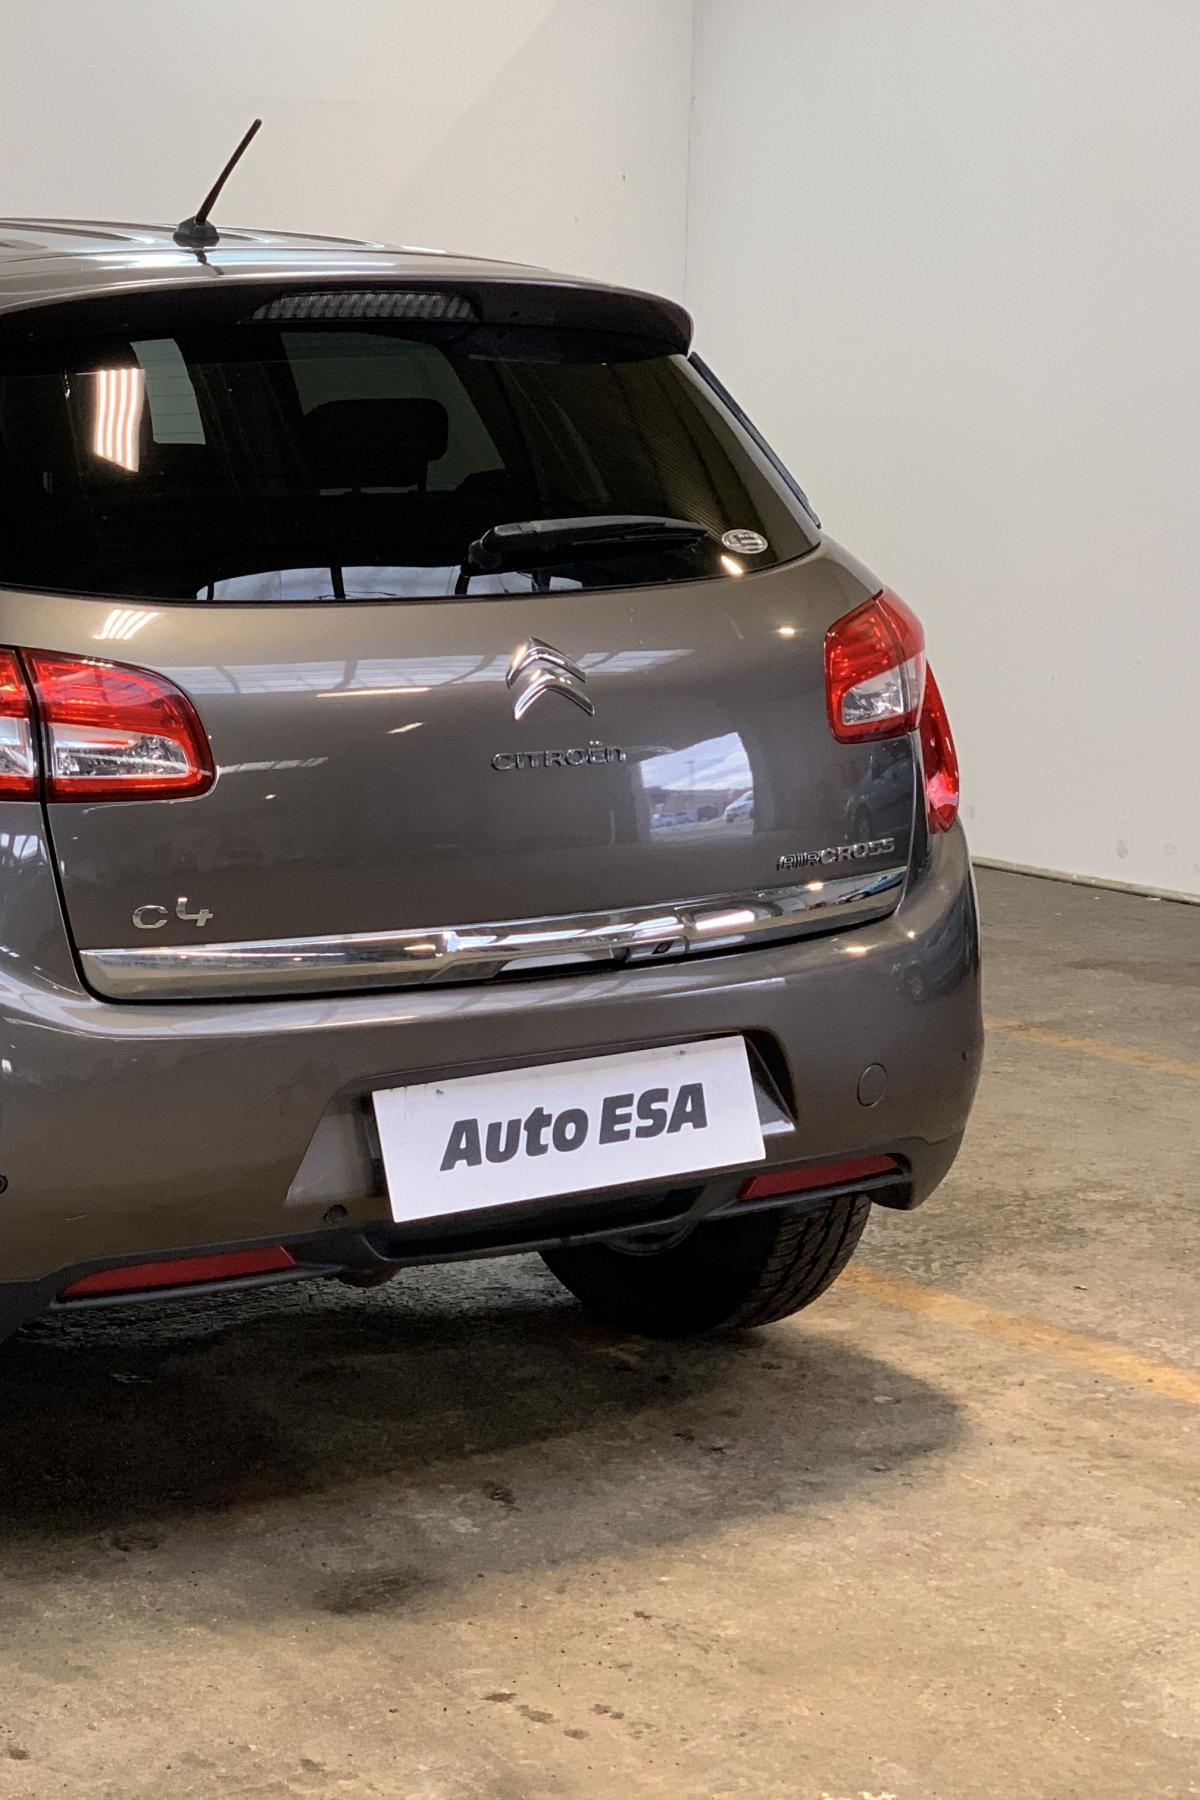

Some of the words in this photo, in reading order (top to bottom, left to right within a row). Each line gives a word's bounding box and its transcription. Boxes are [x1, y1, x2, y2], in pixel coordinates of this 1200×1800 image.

[776, 837, 896, 871] AIRCROSS
[440, 1107, 589, 1172] Auto
[599, 1082, 708, 1145] ESA
